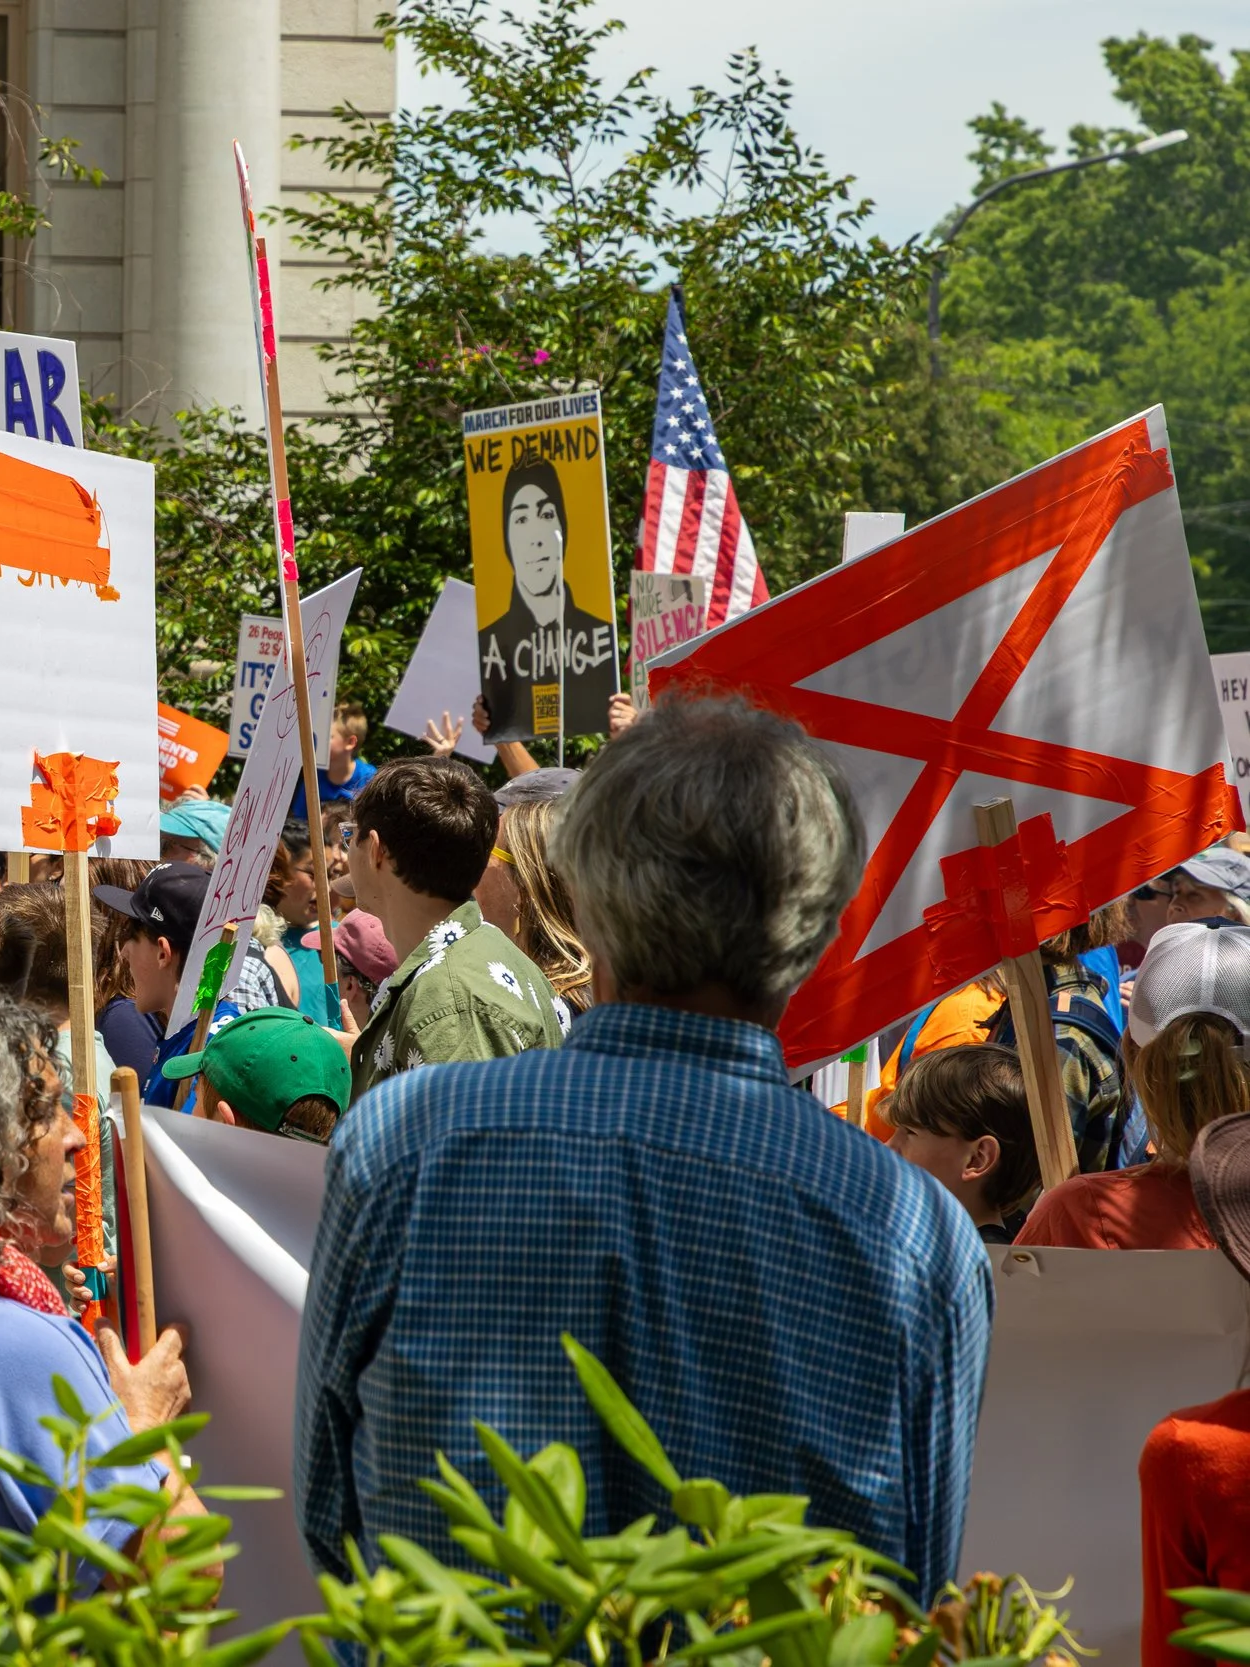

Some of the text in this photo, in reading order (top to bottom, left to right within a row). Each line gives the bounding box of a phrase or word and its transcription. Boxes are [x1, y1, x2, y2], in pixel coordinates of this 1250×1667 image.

[464, 394, 598, 433] MARCH FOR OUR LIVES
[467, 425, 599, 474] WE DEMAND
[636, 574, 655, 594] NO
[634, 592, 662, 618] MORE
[248, 625, 284, 643] 26 Peop
[259, 642, 271, 654] 32
[635, 603, 705, 661] SILENCE
[482, 625, 613, 681] A CHANGE
[1221, 678, 1249, 702] HEY
[256, 757, 294, 834] MY
